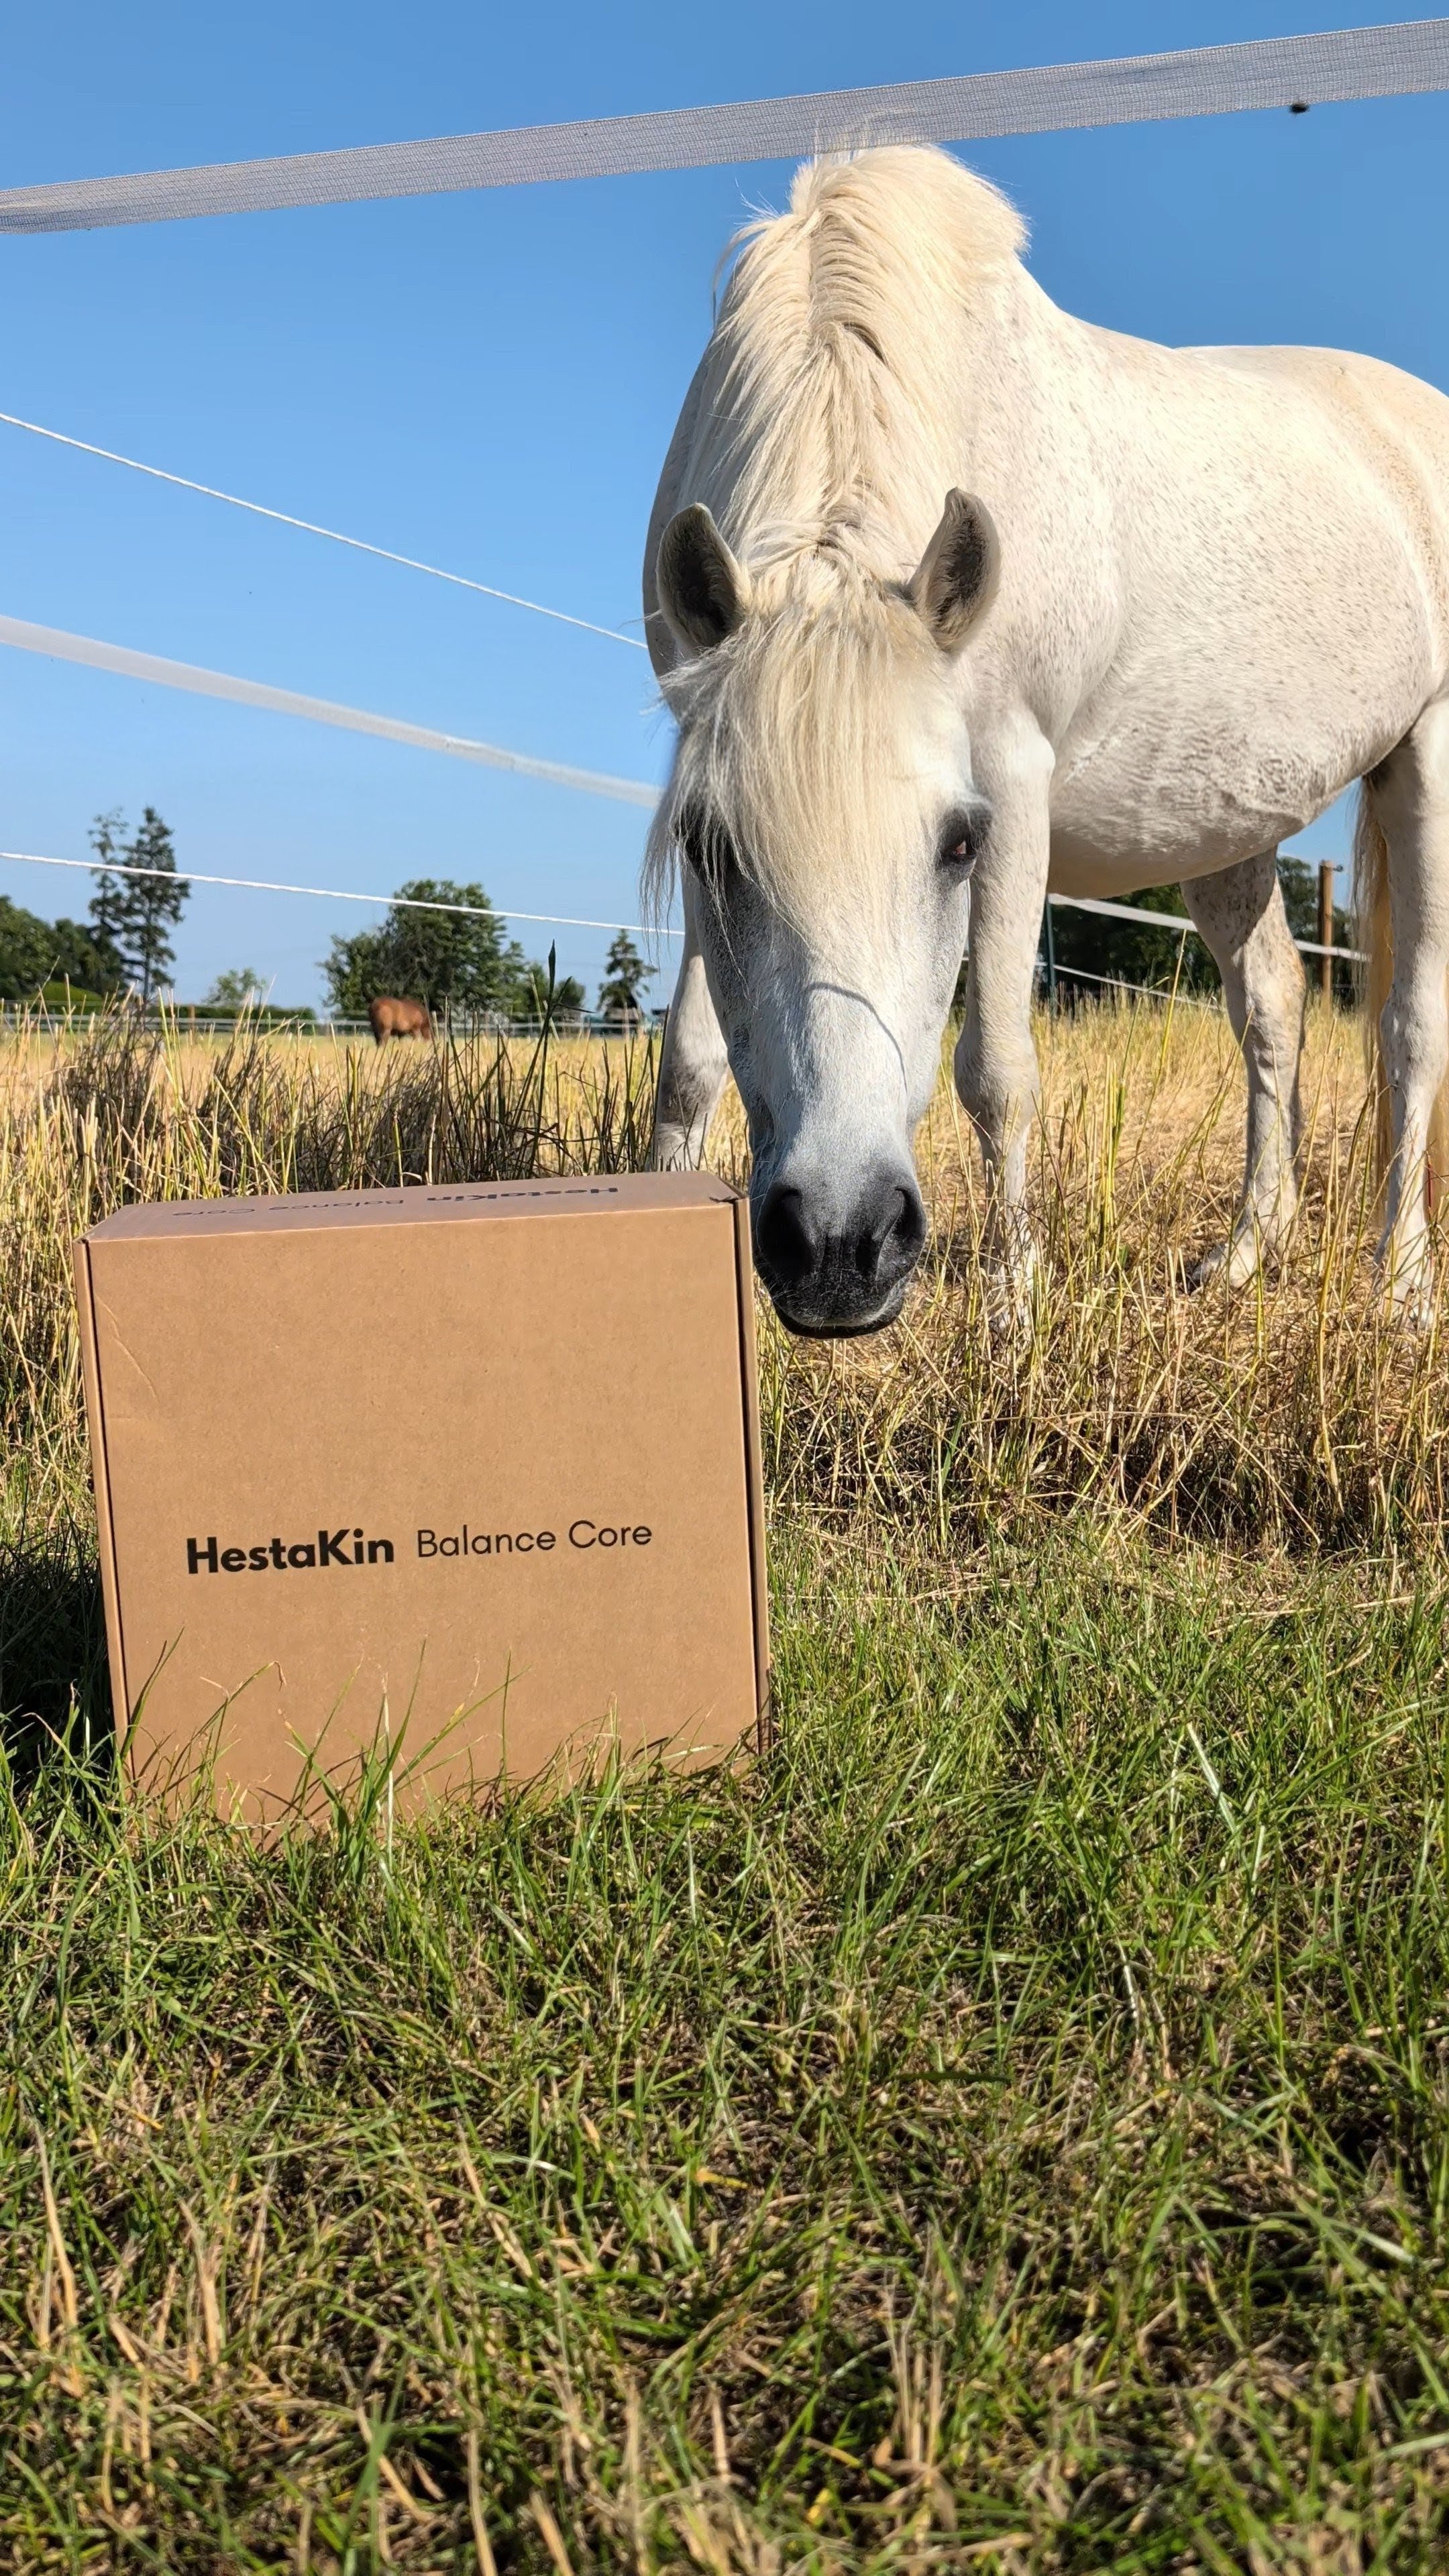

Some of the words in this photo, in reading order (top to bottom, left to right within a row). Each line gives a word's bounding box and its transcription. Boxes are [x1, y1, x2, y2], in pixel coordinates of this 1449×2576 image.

[427, 1187, 619, 1201] HestaKin
[268, 1199, 404, 1210] Balance
[186, 1527, 395, 1574] HestaKin
[417, 1524, 557, 1558] Balance
[568, 1519, 653, 1550] Core
